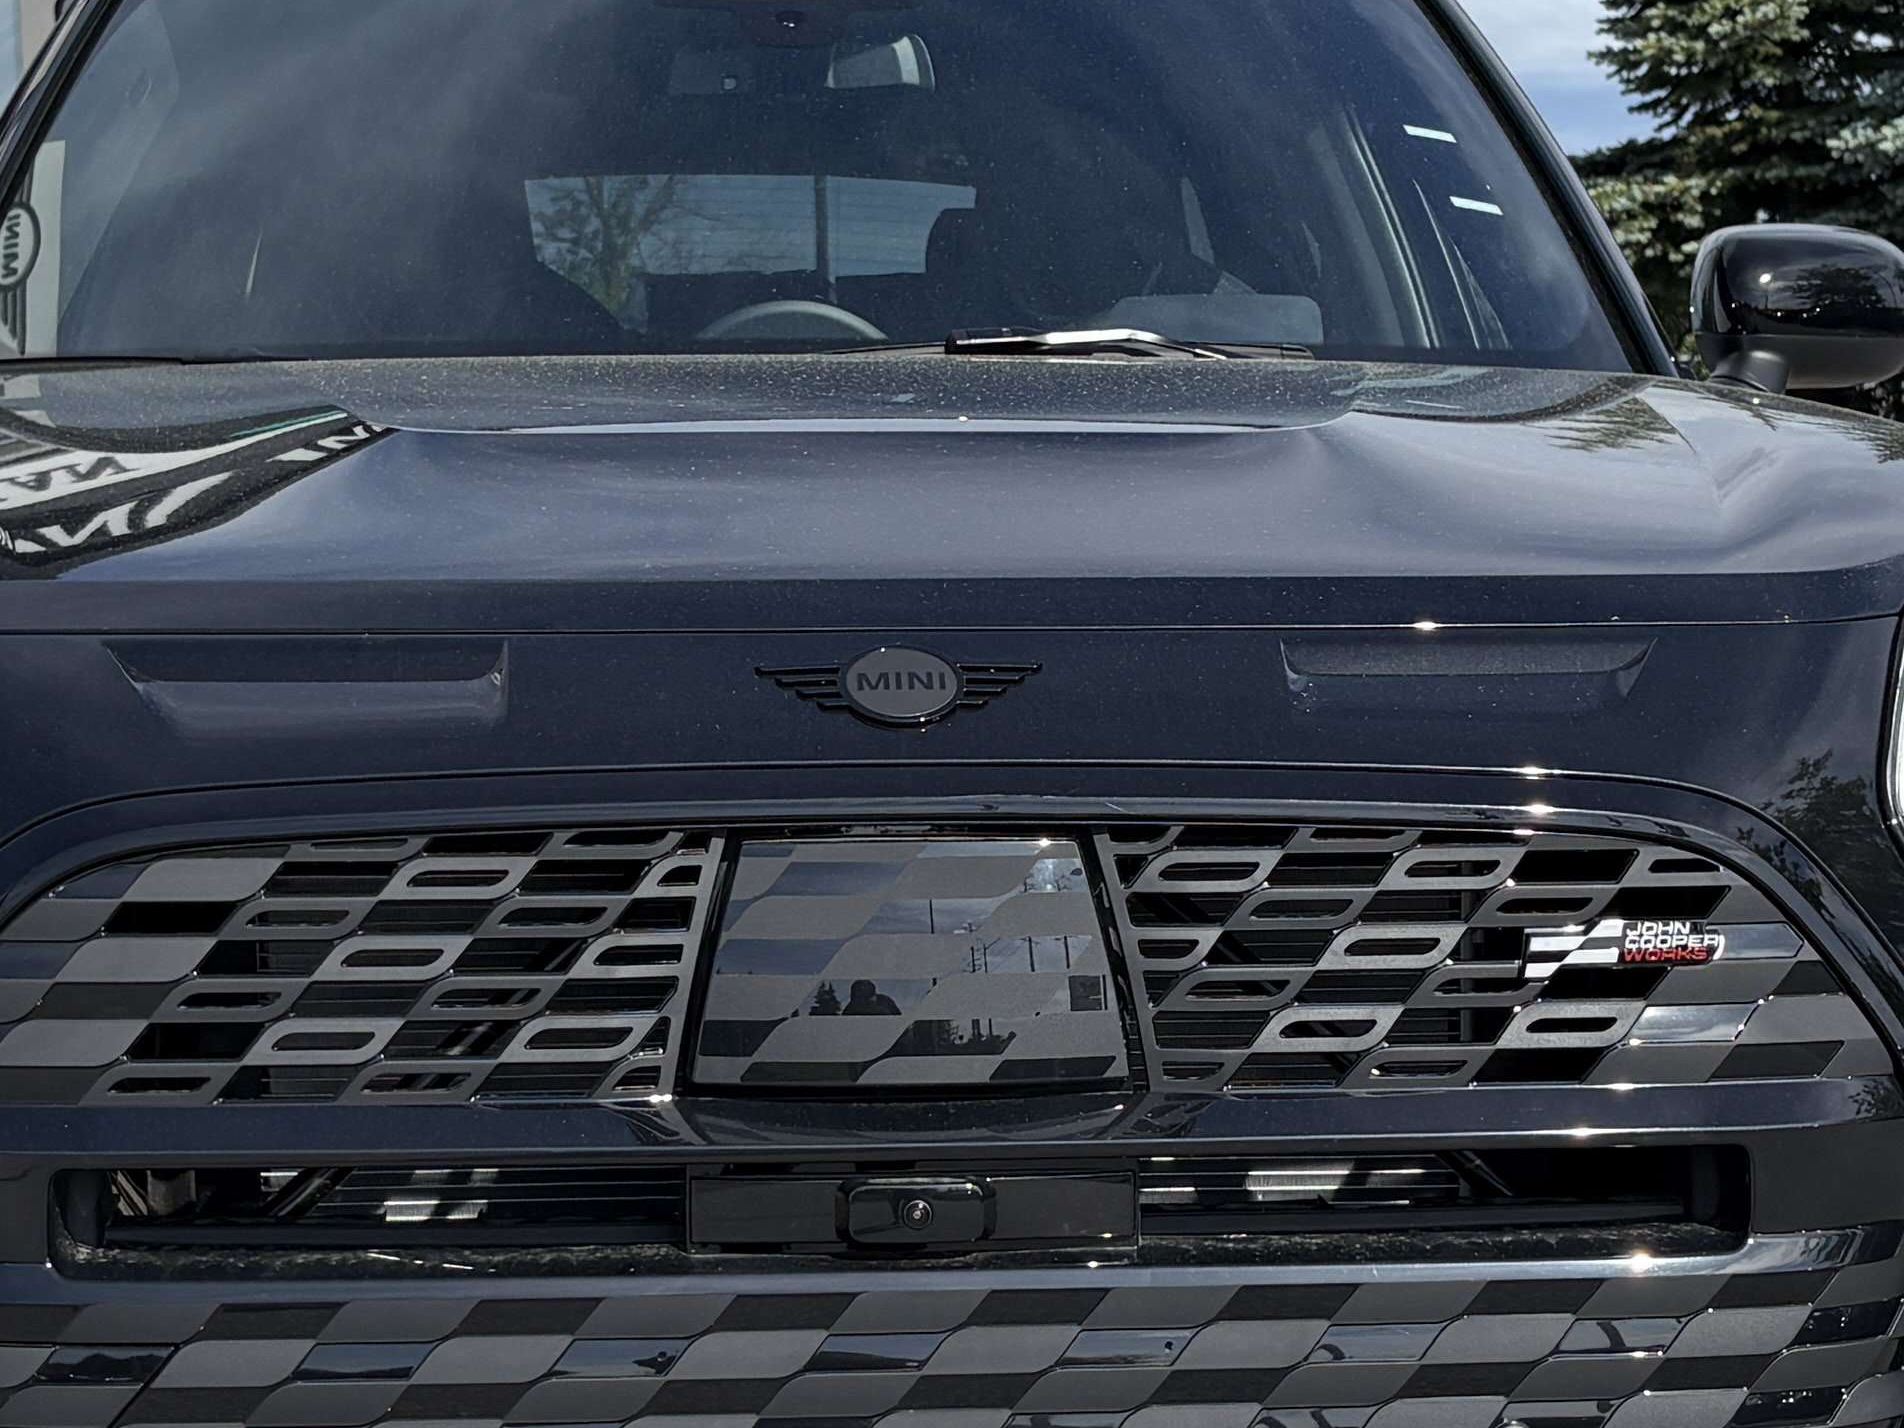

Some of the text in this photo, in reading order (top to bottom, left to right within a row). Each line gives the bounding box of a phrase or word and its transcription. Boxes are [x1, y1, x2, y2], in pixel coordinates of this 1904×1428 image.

[855, 671, 946, 692] MINI
[1626, 922, 1690, 935] JOHN
[1625, 934, 1718, 949] COOPER
[1624, 948, 1707, 961] WORKS
